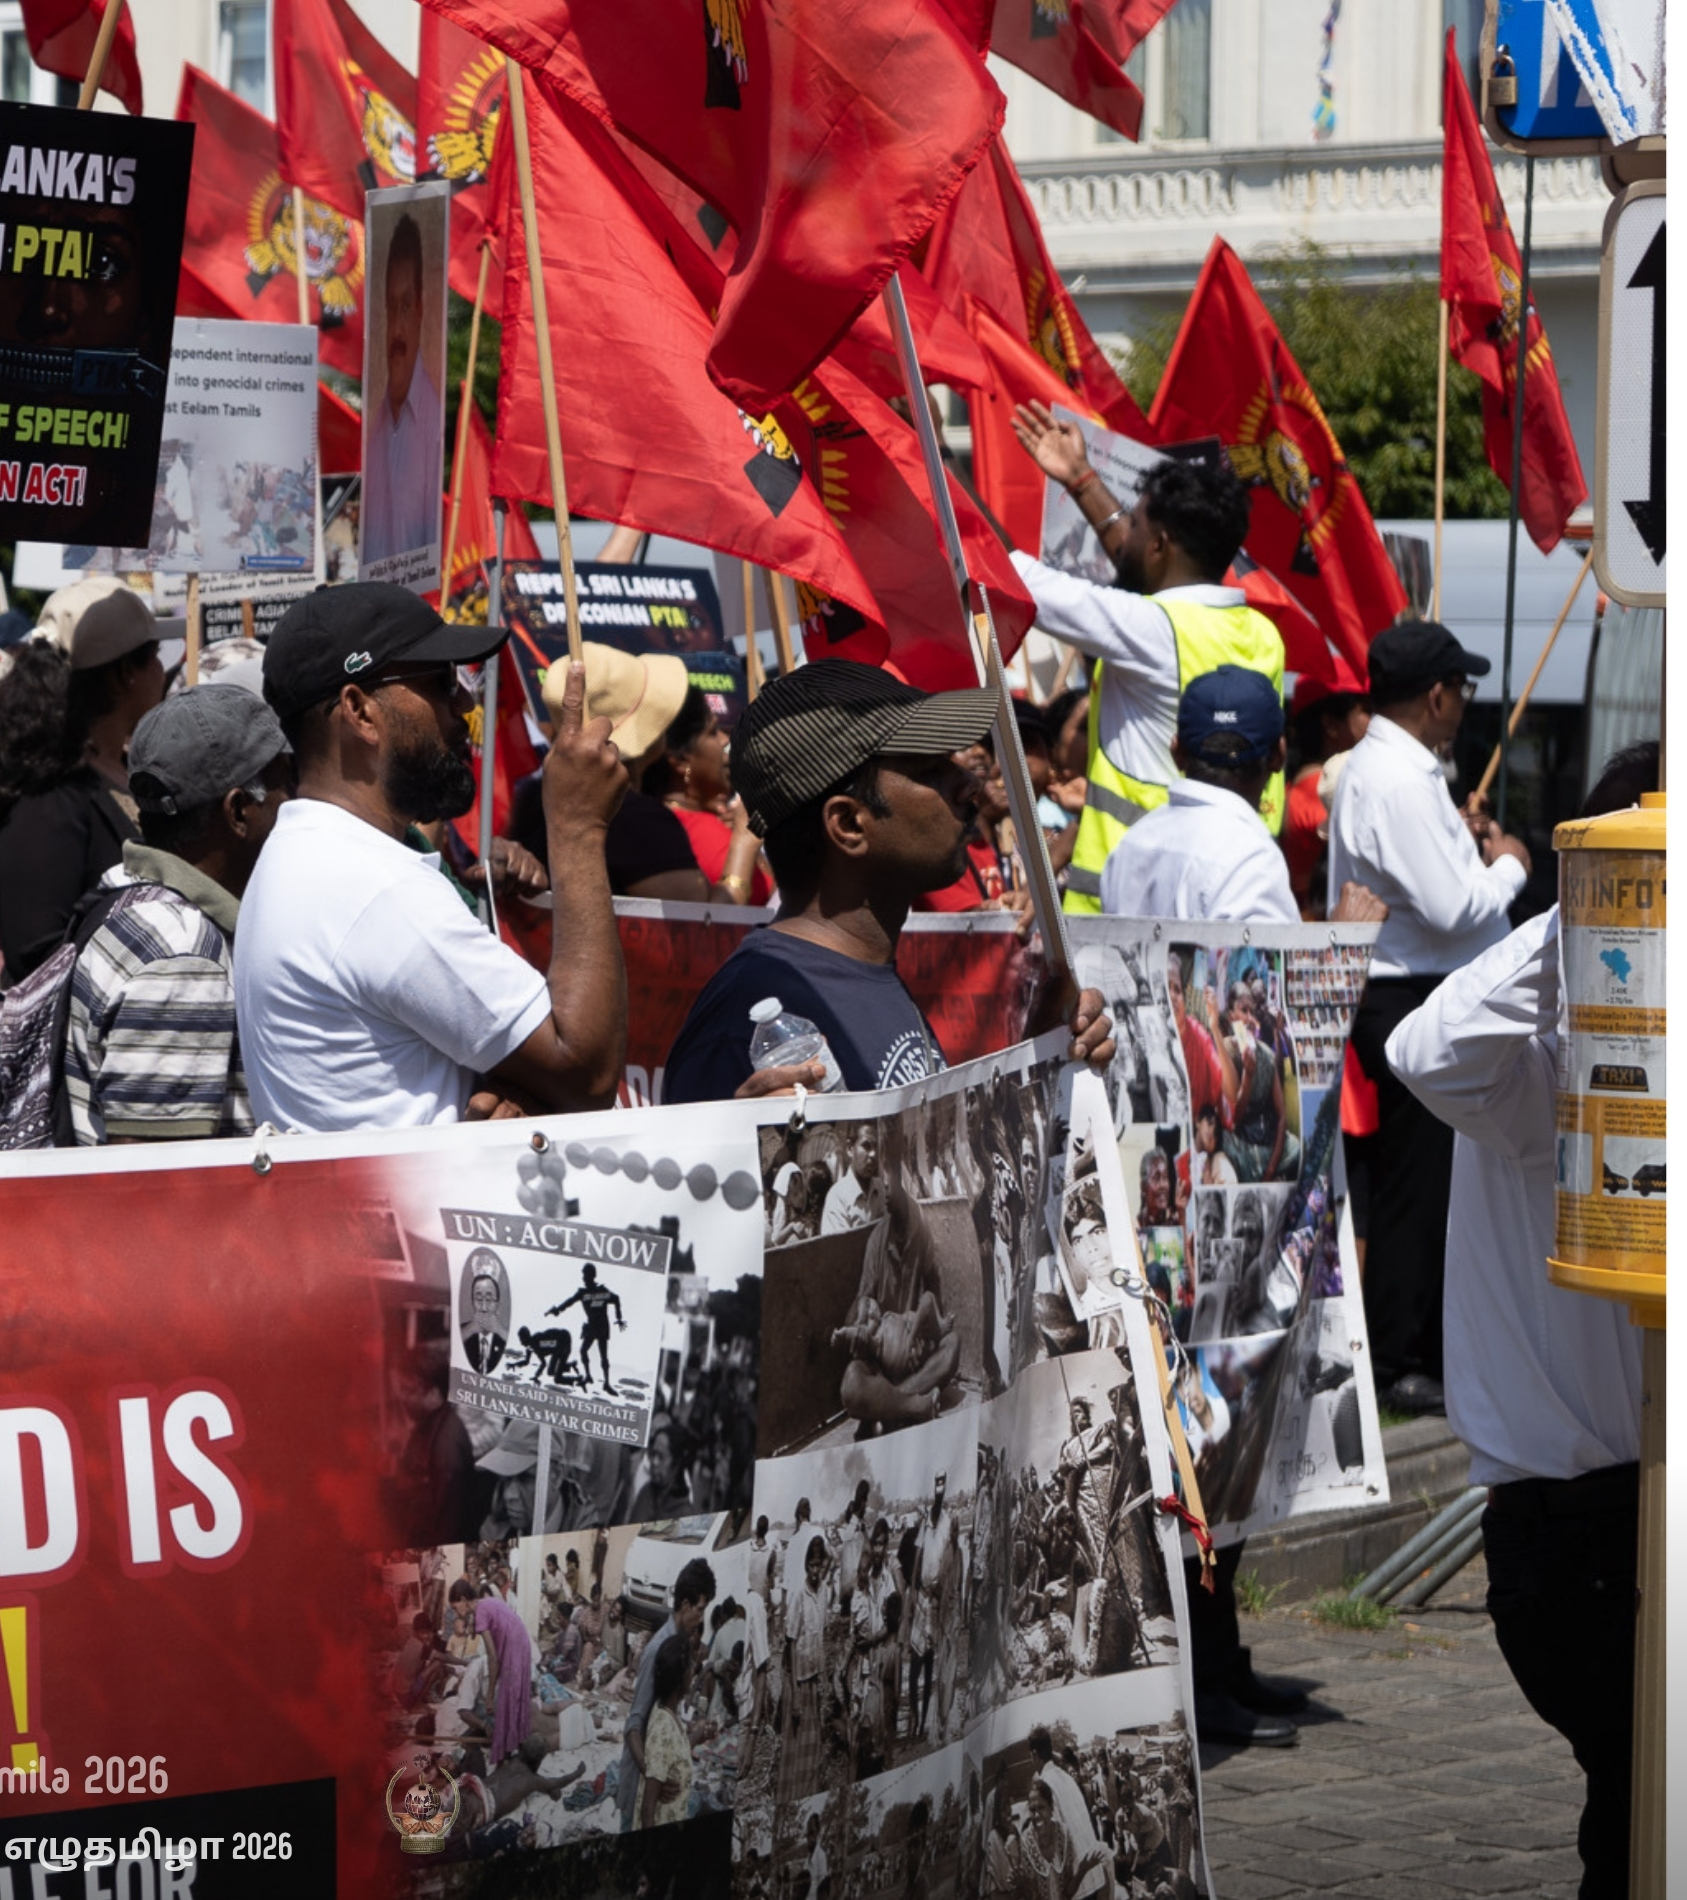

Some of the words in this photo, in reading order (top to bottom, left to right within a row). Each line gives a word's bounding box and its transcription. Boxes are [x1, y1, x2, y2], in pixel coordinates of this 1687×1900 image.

[13, 225, 93, 279] PTA!
[236, 348, 312, 365] international
[175, 373, 199, 387] into
[203, 376, 261, 391] genocidal
[265, 378, 305, 393] crimes
[182, 402, 219, 416] Eelam
[222, 403, 261, 417] Tamils
[15, 406, 129, 449] SPEECH!
[24, 463, 88, 506] ACT!
[515, 572, 589, 595] REPEL
[589, 574, 622, 596] SRI
[622, 576, 697, 600] LANKA'S
[542, 602, 651, 626] DRCONIAN
[1213, 710, 1237, 723] NIKE
[1593, 878, 1654, 909] INFO
[1600, 1066, 1634, 1083] TAXI
[453, 1214, 497, 1242] UN
[519, 1221, 578, 1254] ACT
[583, 1231, 658, 1268] NOW
[461, 1373, 479, 1386] UN
[480, 1378, 516, 1397] PANEL
[518, 1387, 548, 1404] SAID
[555, 1392, 637, 1422] INVESTIGATE
[456, 1388, 478, 1407] SRI
[544, 1409, 580, 1430] WAR
[581, 1417, 639, 1443] CRIMES
[118, 1390, 244, 1565] IS
